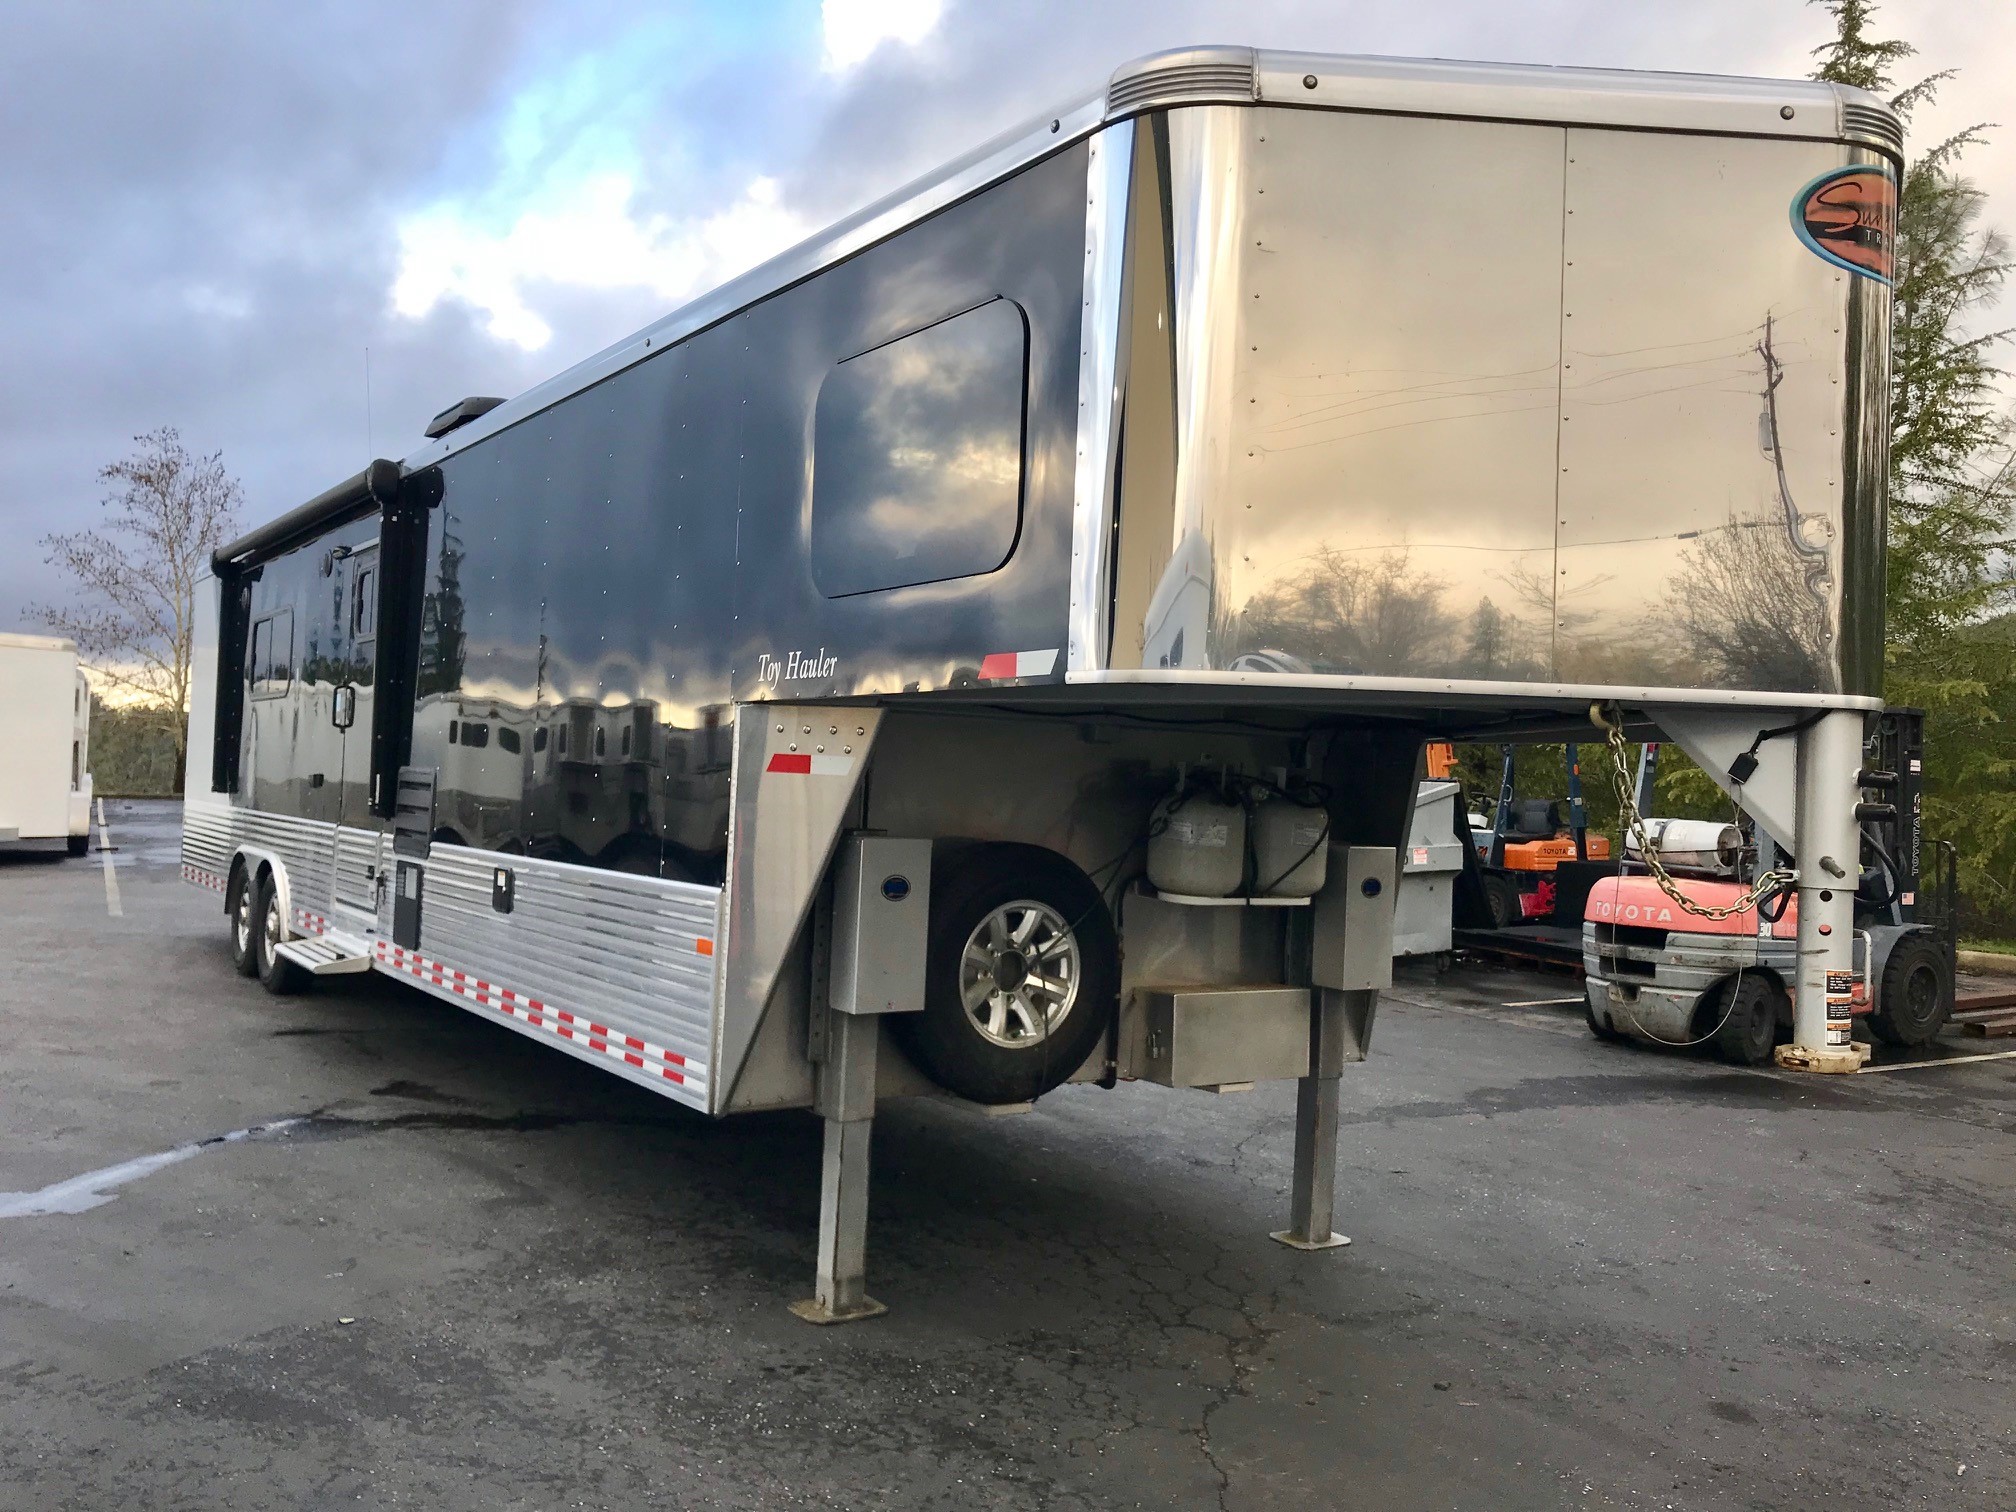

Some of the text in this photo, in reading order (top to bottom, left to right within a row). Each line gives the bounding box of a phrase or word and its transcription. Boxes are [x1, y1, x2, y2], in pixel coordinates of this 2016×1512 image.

[758, 647, 838, 691] Toy Hauler
[1911, 816, 1920, 877] TOYOTA
[1595, 901, 1673, 922] TOYOTA
[1759, 922, 1772, 937] 30
